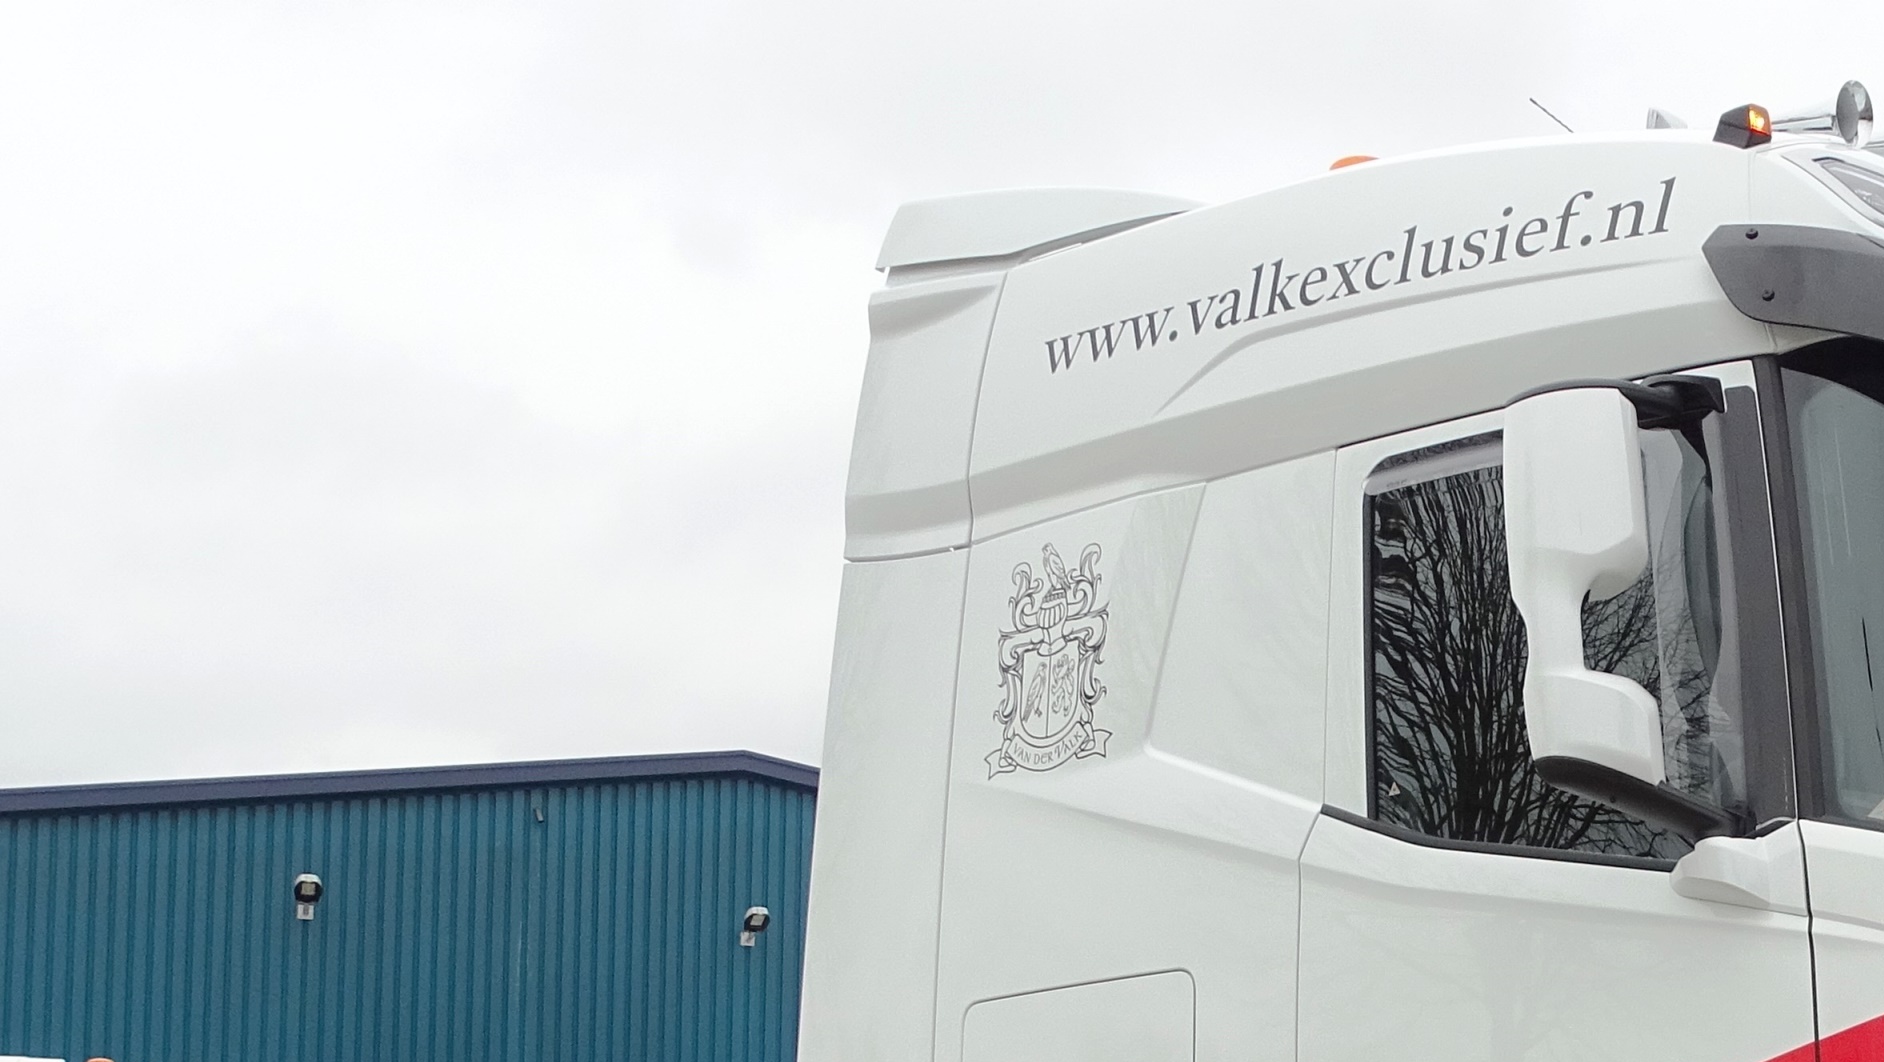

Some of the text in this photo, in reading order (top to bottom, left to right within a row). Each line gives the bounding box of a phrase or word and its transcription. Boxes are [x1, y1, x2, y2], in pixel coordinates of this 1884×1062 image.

[1043, 176, 1678, 374] www.valkexclusief.nl
[1013, 730, 1083, 765] VAN DER VALK
